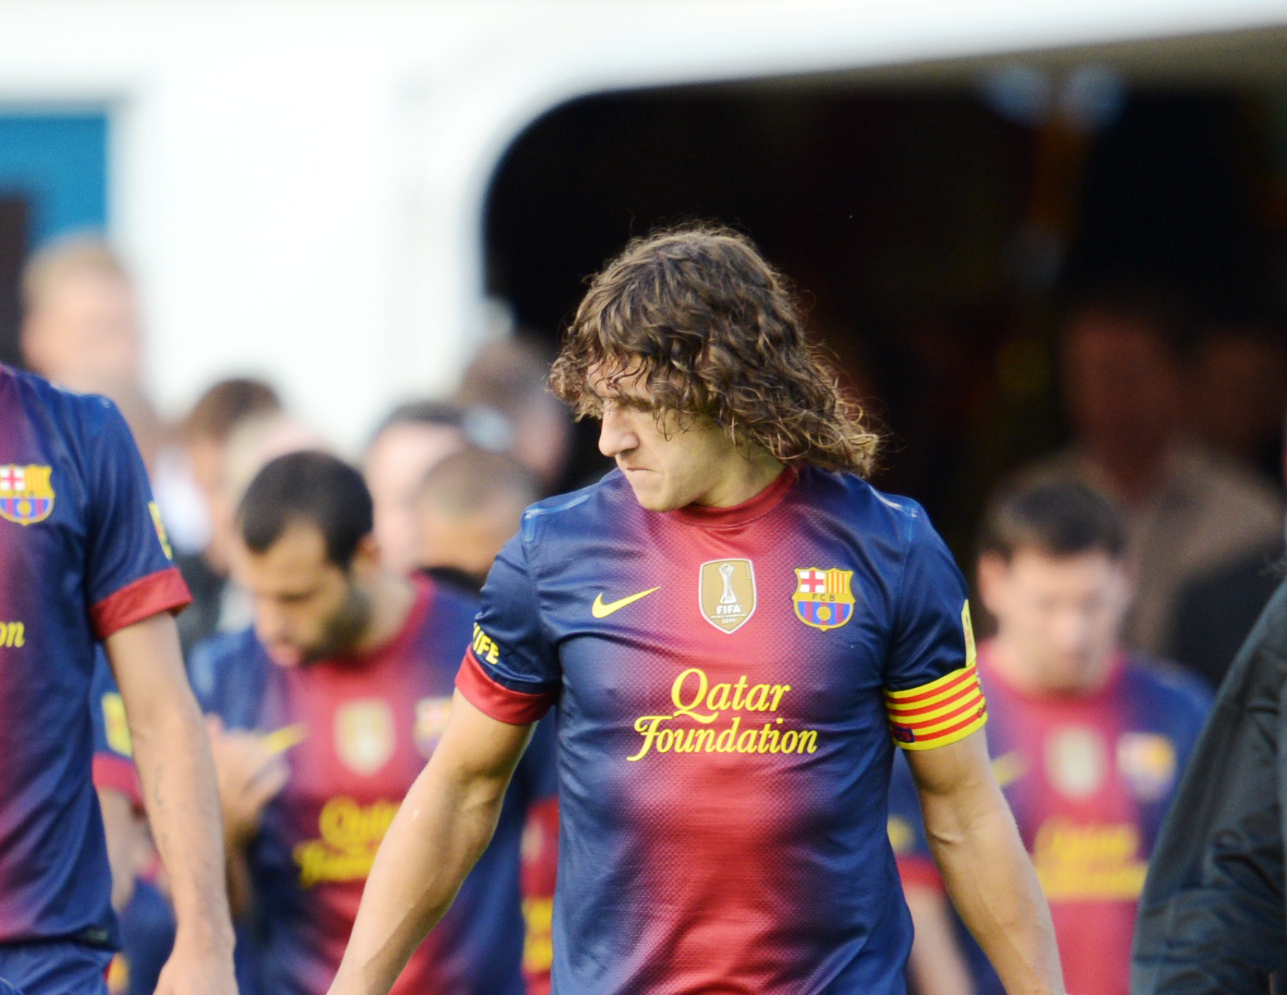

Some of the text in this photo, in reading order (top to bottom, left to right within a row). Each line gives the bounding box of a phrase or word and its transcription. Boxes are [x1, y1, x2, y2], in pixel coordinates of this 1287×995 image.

[716, 604, 742, 615] FIFA
[671, 668, 791, 724] Qatar
[626, 716, 817, 762] Foundation
